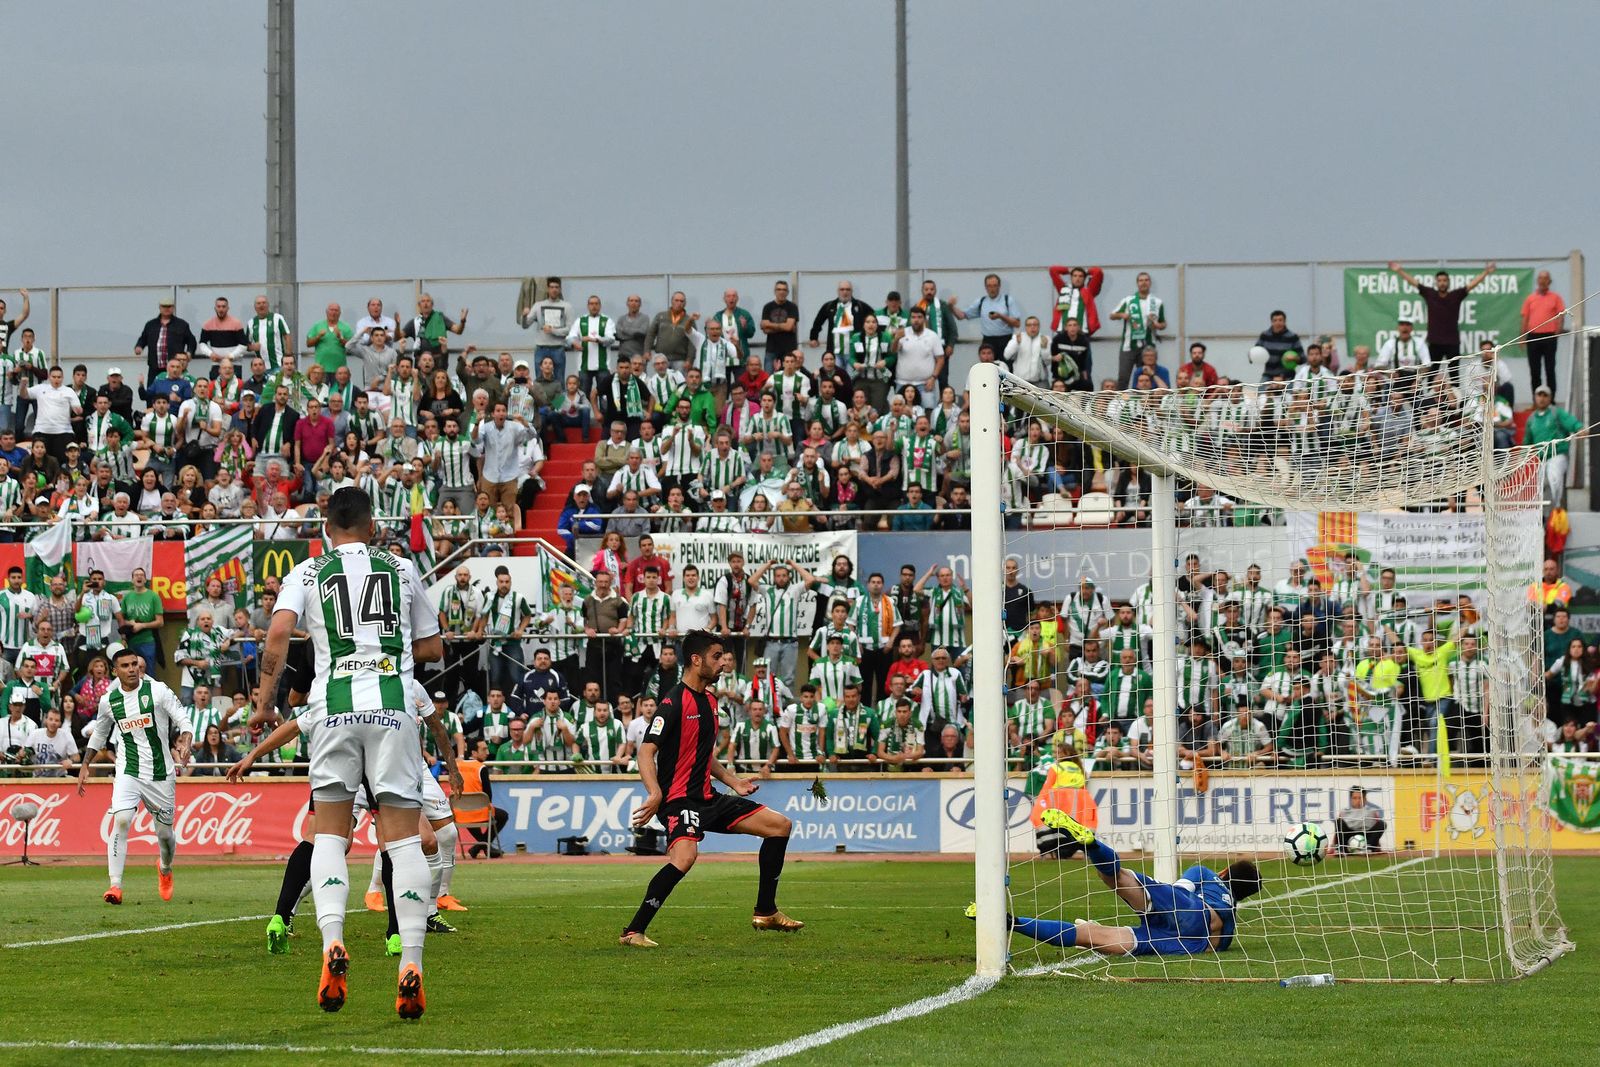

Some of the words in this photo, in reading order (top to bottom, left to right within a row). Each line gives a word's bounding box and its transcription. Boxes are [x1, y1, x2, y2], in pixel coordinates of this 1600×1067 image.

[1358, 272, 1399, 294] PEÑA
[680, 538, 705, 564] PEÑA
[747, 543, 820, 564] BLANQUIVERDE
[302, 554, 334, 587] SERGI
[320, 572, 399, 638] 14
[120, 716, 151, 734] tango
[343, 713, 402, 731] HYUNDAI
[785, 795, 917, 812] AUDIOLOGIA
[680, 809, 700, 828] 15
[843, 823, 918, 840] VISUAL
